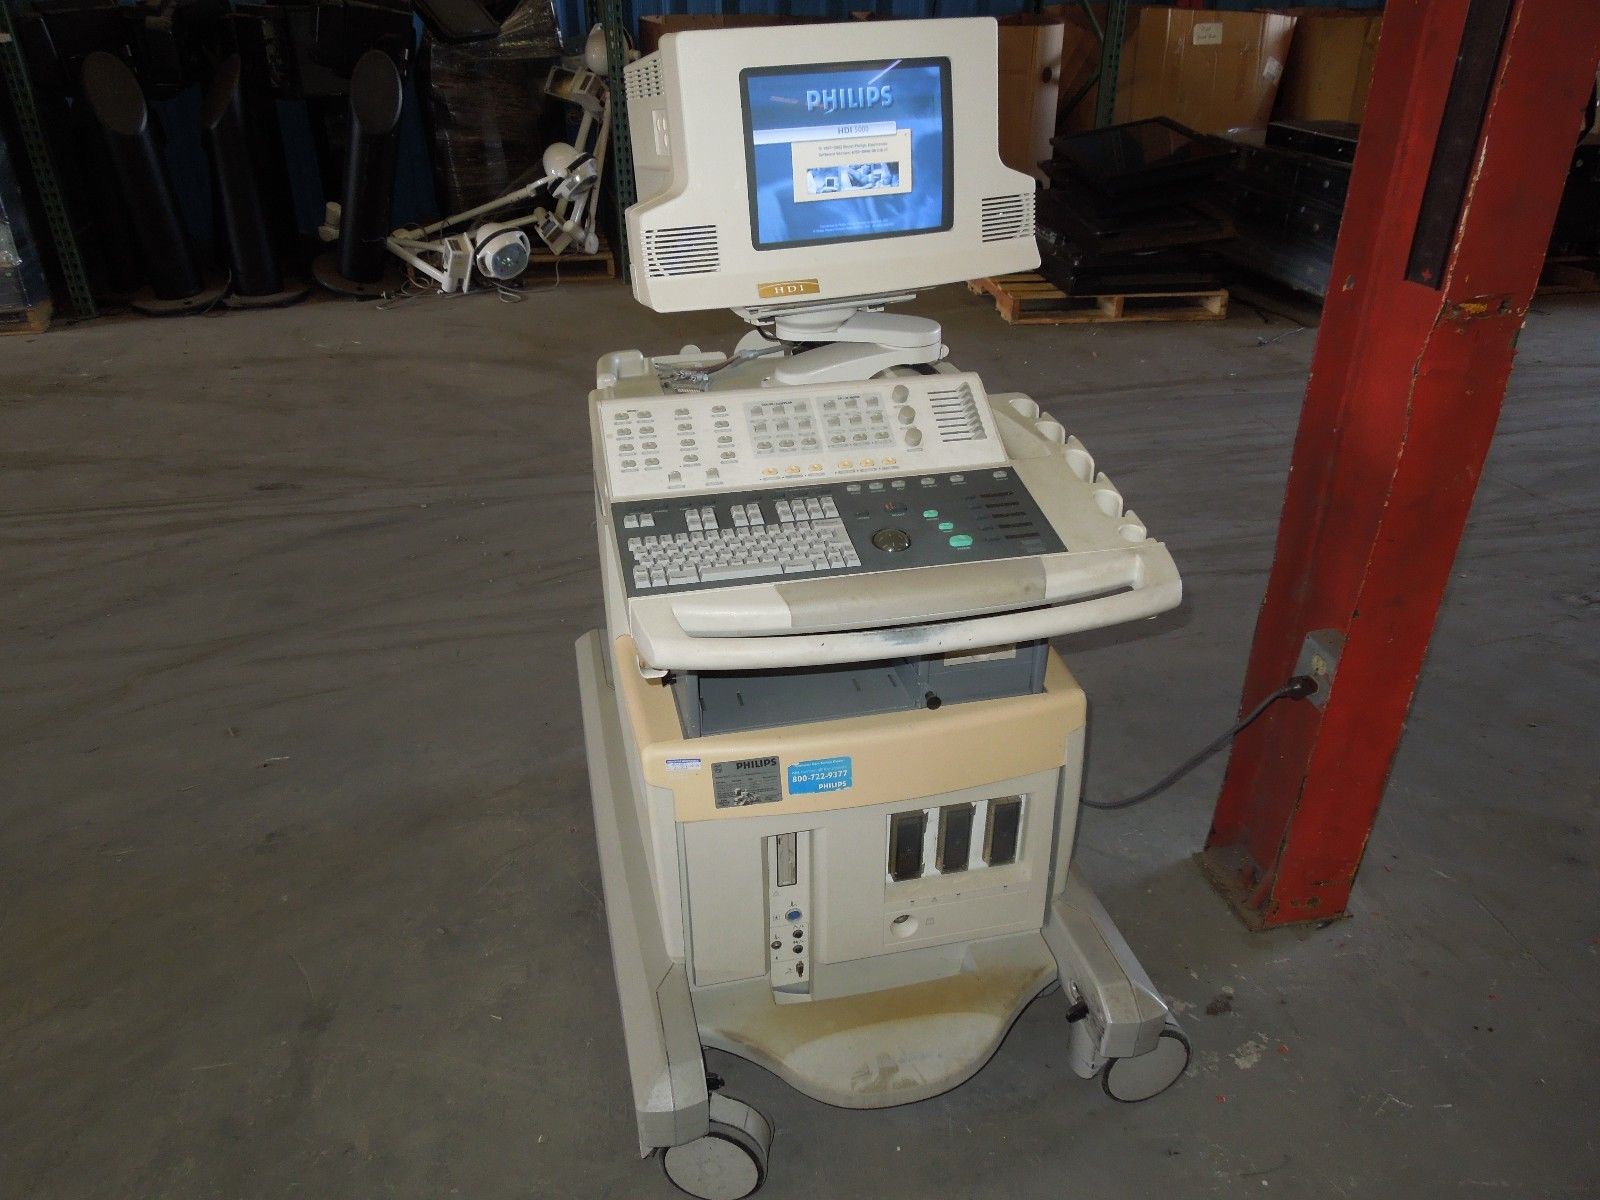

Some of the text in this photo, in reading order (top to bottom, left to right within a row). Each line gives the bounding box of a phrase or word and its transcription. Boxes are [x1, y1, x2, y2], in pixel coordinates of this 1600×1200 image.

[806, 85, 894, 114] PHILIPS
[837, 126, 853, 135] HDI
[774, 284, 804, 294] HDI
[736, 757, 777, 770] PHILIPS
[792, 769, 848, 783] 800-722-9377
[818, 780, 847, 790] PHILIPS
